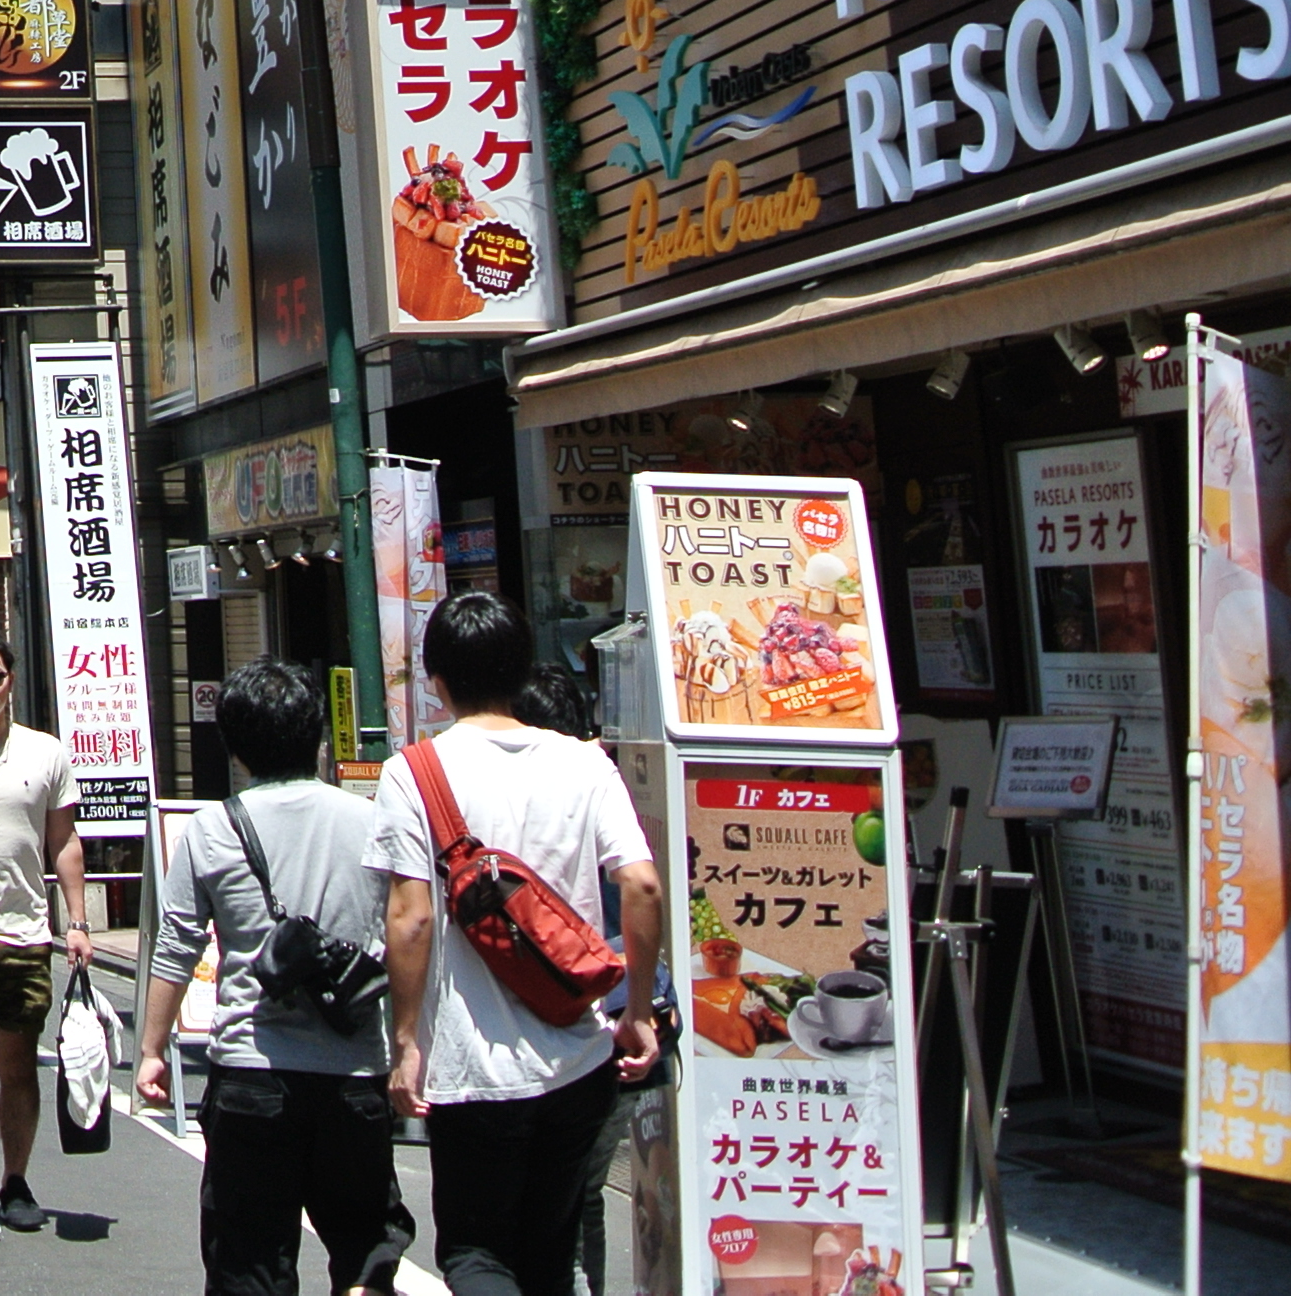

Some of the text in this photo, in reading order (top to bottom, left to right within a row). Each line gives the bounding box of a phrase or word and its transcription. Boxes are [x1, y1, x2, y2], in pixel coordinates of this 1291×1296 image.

[58, 70, 87, 91] 2F
[3, 220, 86, 242] 相席酒場
[148, 80, 177, 387] 相席酒場
[625, 159, 821, 284] Pasela Resorts
[465, 243, 532, 267] ハニトー
[476, 264, 513, 281] HONEY
[476, 275, 510, 290] TOAST
[274, 276, 307, 346] 5F
[555, 444, 678, 474] ハニトー
[1033, 481, 1135, 507] PASELA RESORTS
[59, 427, 116, 603] 相席酒場
[656, 496, 787, 523] HONEY
[802, 508, 840, 525] パセラ
[661, 524, 791, 558] ハニトー
[1036, 508, 1138, 554] カラオケ
[663, 560, 792, 588] TOAST
[62, 643, 138, 680] 女性
[65, 682, 138, 697] グループ様
[1066, 673, 1137, 691] PRICE LIST
[66, 699, 138, 711] 時間無制限
[75, 712, 132, 724] 飲み放題
[69, 727, 147, 768] 無料
[734, 784, 831, 808] 1F カフェ
[79, 804, 128, 819] 1,500円
[755, 825, 848, 846] SQUALL CAFE
[703, 863, 873, 890] スイーツ&ガレット
[1215, 752, 1247, 976] パセラ名物
[733, 892, 843, 930] カフェ
[742, 1077, 849, 1096] 曲数世界最強
[732, 1099, 860, 1123] PASELA
[710, 1133, 885, 1170] カラオケ&
[711, 1170, 888, 1209] パーティー
[711, 1227, 755, 1245] 女性専用
[720, 1240, 750, 1255] フロア
